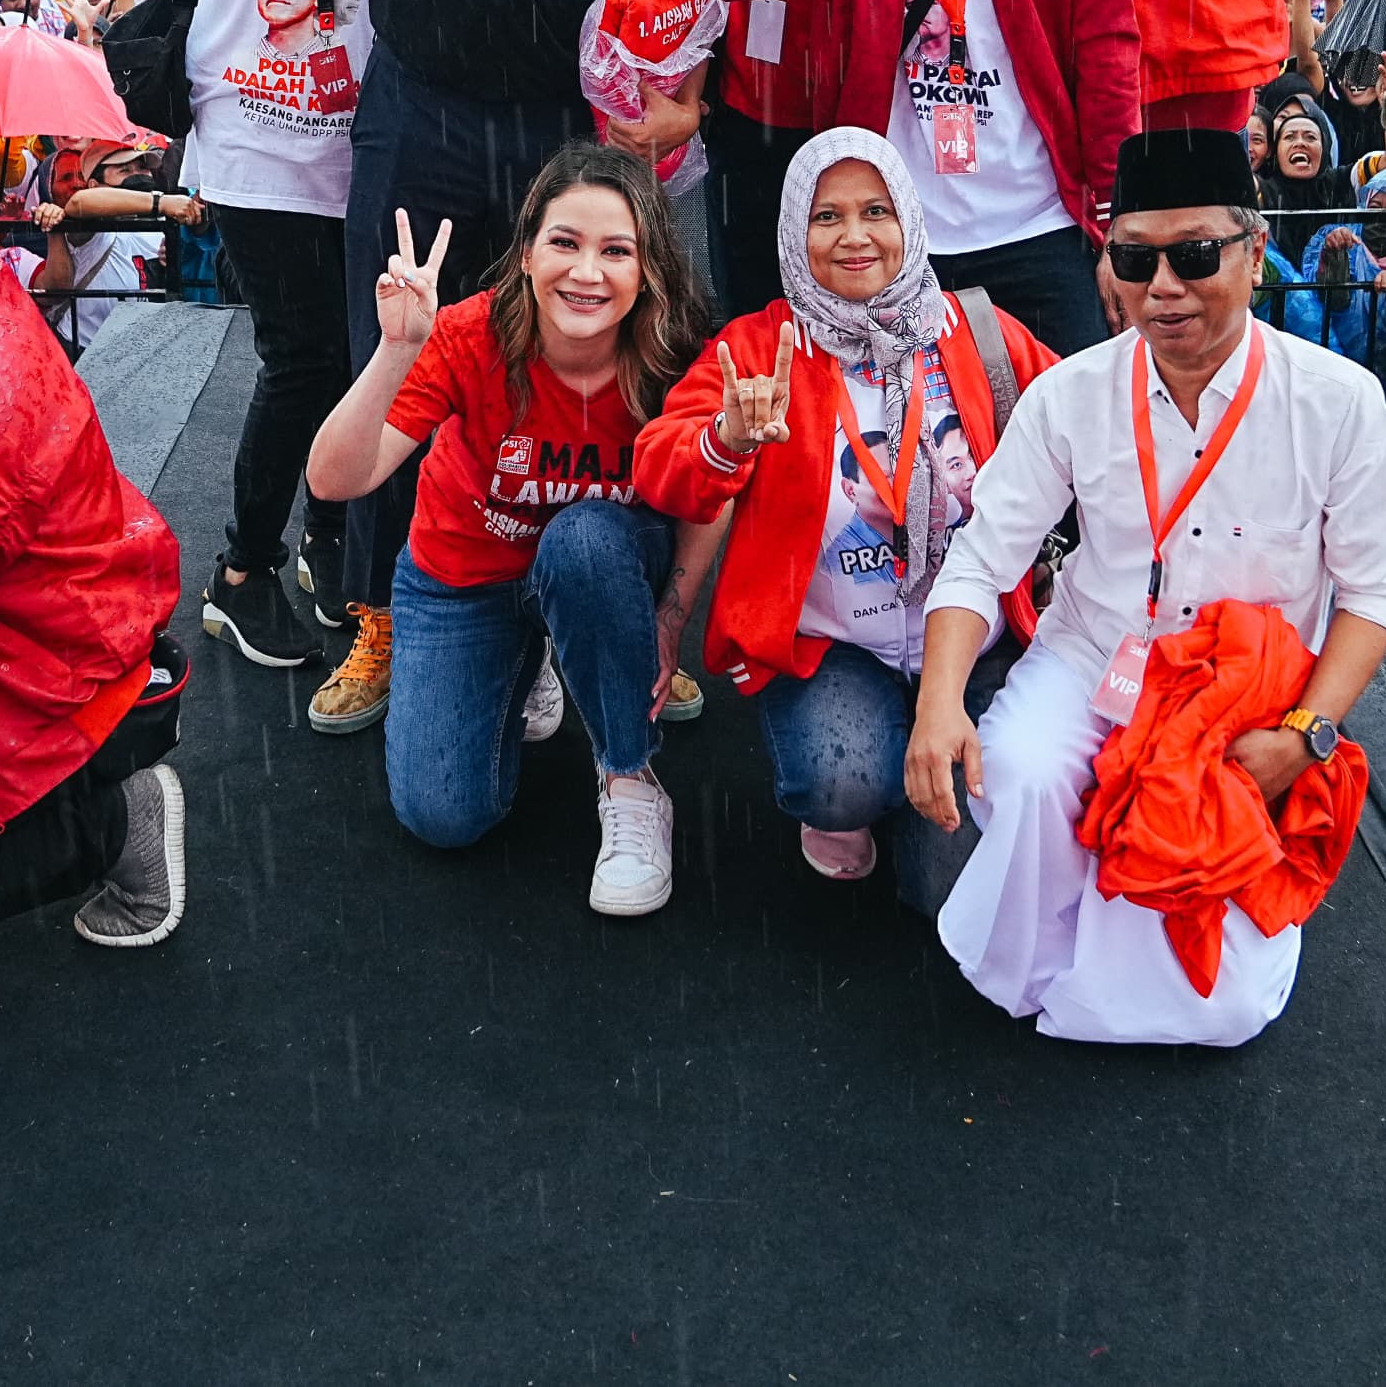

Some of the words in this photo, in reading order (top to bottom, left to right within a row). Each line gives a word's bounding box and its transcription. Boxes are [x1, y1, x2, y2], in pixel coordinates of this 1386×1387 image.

[222, 66, 305, 94] ADALAH
[320, 78, 348, 95] VIP
[238, 87, 301, 111] NINJA
[908, 81, 989, 107] OKOWI
[239, 97, 293, 122] KAESANG
[296, 116, 353, 128] PANGARE
[243, 110, 276, 127] KETUA
[278, 122, 309, 135] UMUM
[311, 128, 333, 137] DPP
[334, 129, 349, 138] PSI
[938, 140, 969, 154] VIP
[537, 441, 634, 483] MAJ
[853, 606, 878, 619] DAN
[1109, 670, 1140, 695] VIP
